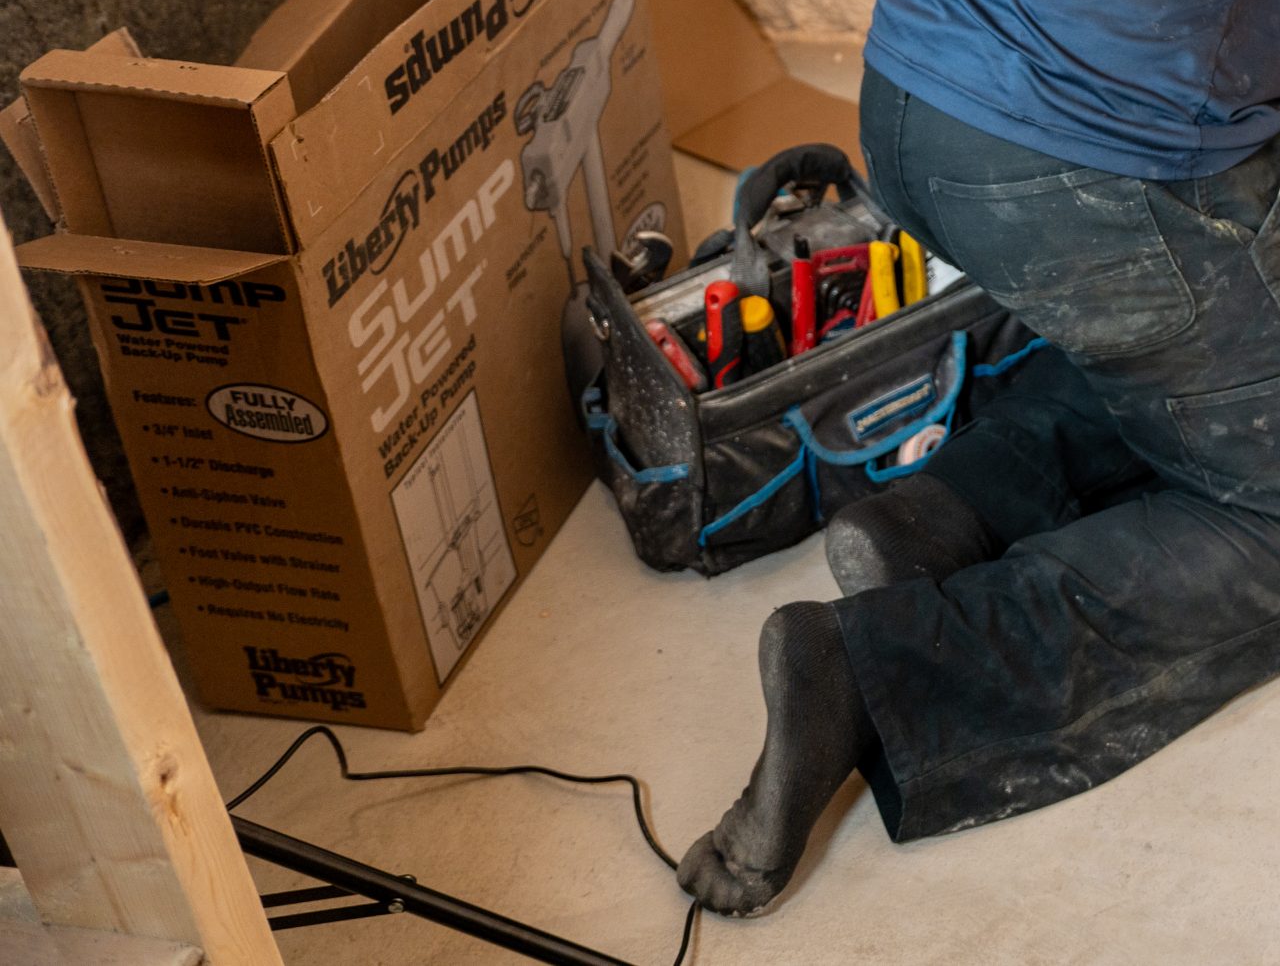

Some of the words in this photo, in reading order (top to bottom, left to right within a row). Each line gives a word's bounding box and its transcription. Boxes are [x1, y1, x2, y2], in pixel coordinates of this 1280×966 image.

[322, 182, 420, 309] Liberty
[419, 90, 508, 203] Pumps
[348, 158, 515, 376] SUMP
[117, 333, 161, 348] Water
[166, 338, 230, 355] Powered
[121, 346, 183, 362] Back-Up
[187, 352, 229, 367] Pump
[362, 263, 484, 433] JET
[132, 390, 197, 408] Features:
[229, 390, 297, 411] FULLY
[378, 407, 418, 459] Water
[421, 333, 476, 407] Powered
[224, 405, 314, 435] Assembled
[384, 407, 438, 479] Back-Up
[440, 360, 476, 408] Pump
[209, 460, 275, 479] Discharge
[249, 494, 286, 509] Valve
[235, 522, 261, 534] PVC
[264, 525, 344, 545] Construction
[221, 549, 257, 564] Valve
[259, 554, 288, 567] with
[243, 646, 356, 688] Liberty
[251, 671, 367, 711] Pumps
